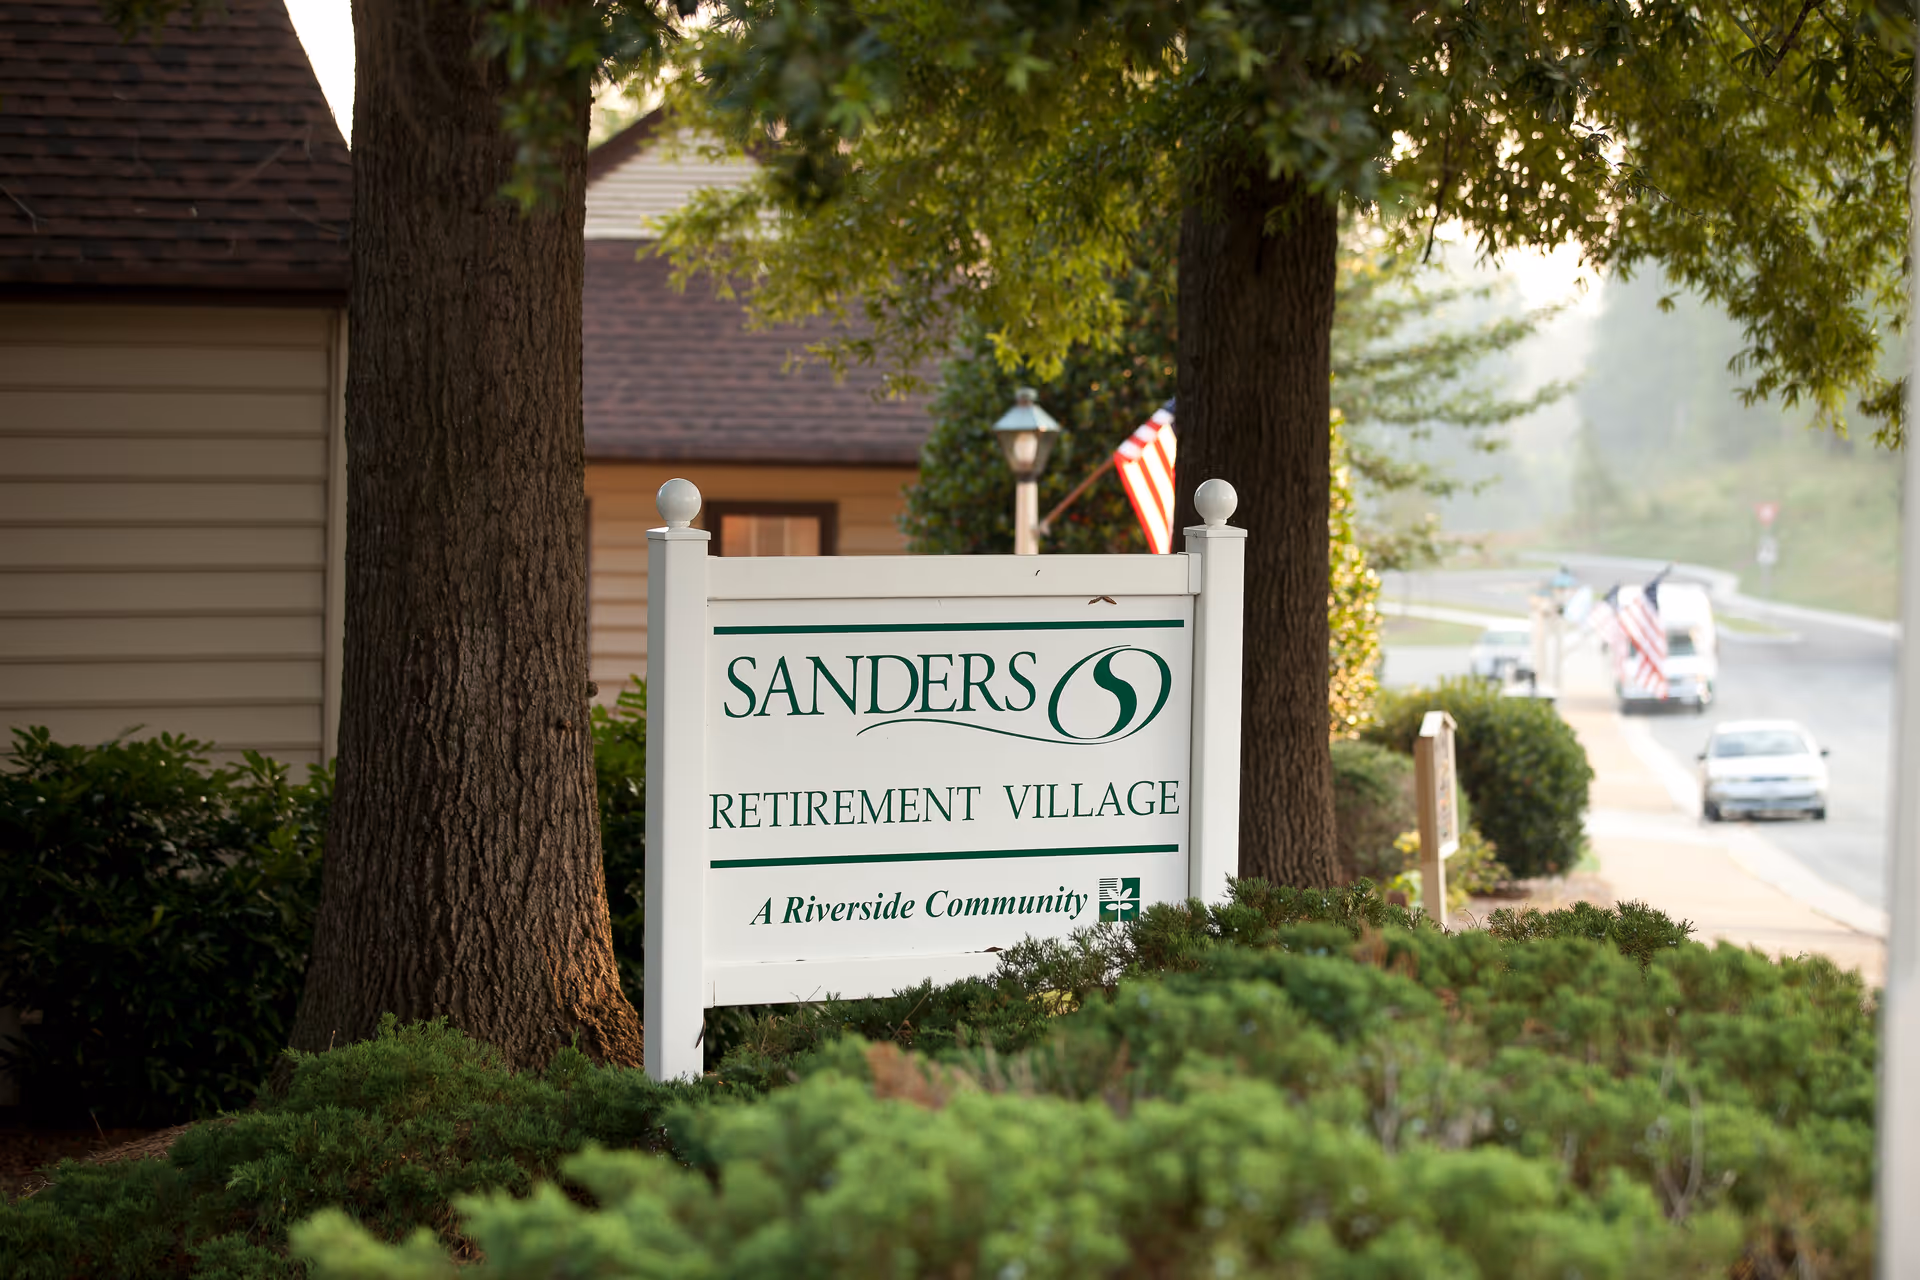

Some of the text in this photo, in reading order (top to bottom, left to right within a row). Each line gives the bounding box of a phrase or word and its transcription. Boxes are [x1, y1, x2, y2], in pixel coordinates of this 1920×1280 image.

[724, 651, 1037, 718] SANDERS
[709, 780, 1181, 829] RETIREMENT VILLAGE
[750, 886, 1088, 925] A Riverside Community
